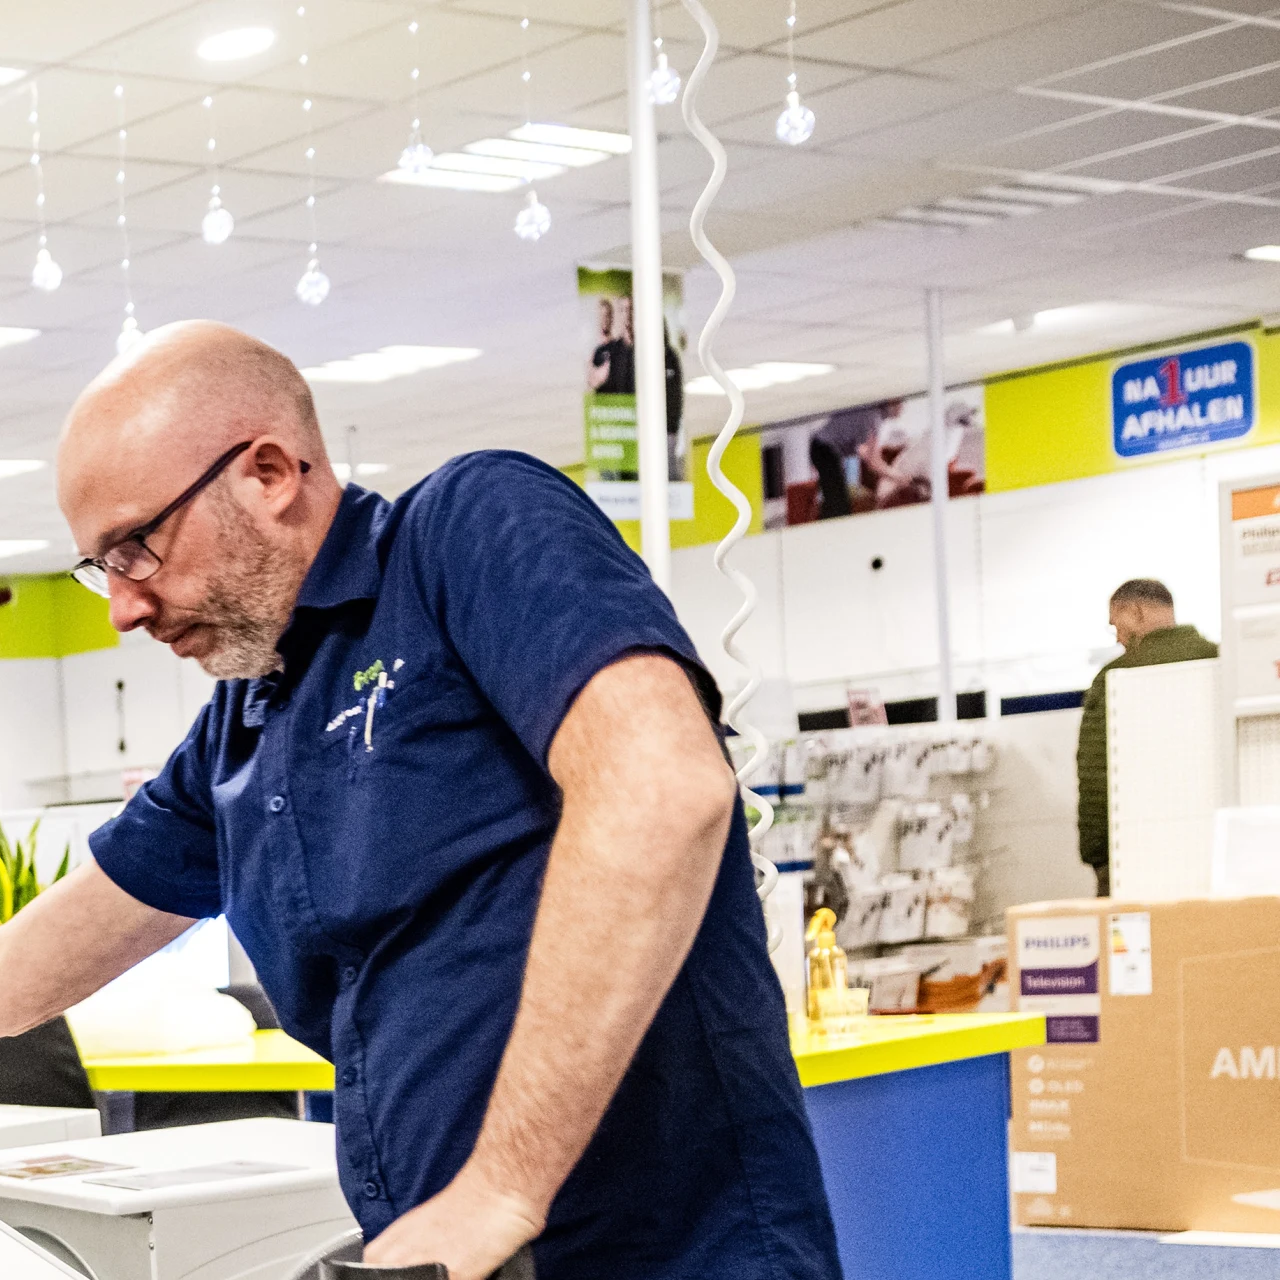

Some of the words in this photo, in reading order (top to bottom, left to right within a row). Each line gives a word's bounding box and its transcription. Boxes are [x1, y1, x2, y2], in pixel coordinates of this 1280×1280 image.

[1123, 376, 1160, 404] NA
[1159, 358, 1187, 408] 1
[1184, 360, 1237, 392] UUR
[1121, 394, 1244, 441] AFHALEN
[1025, 934, 1090, 949] PHILIPS
[1026, 975, 1086, 990] Television
[1210, 1045, 1280, 1081] AM
